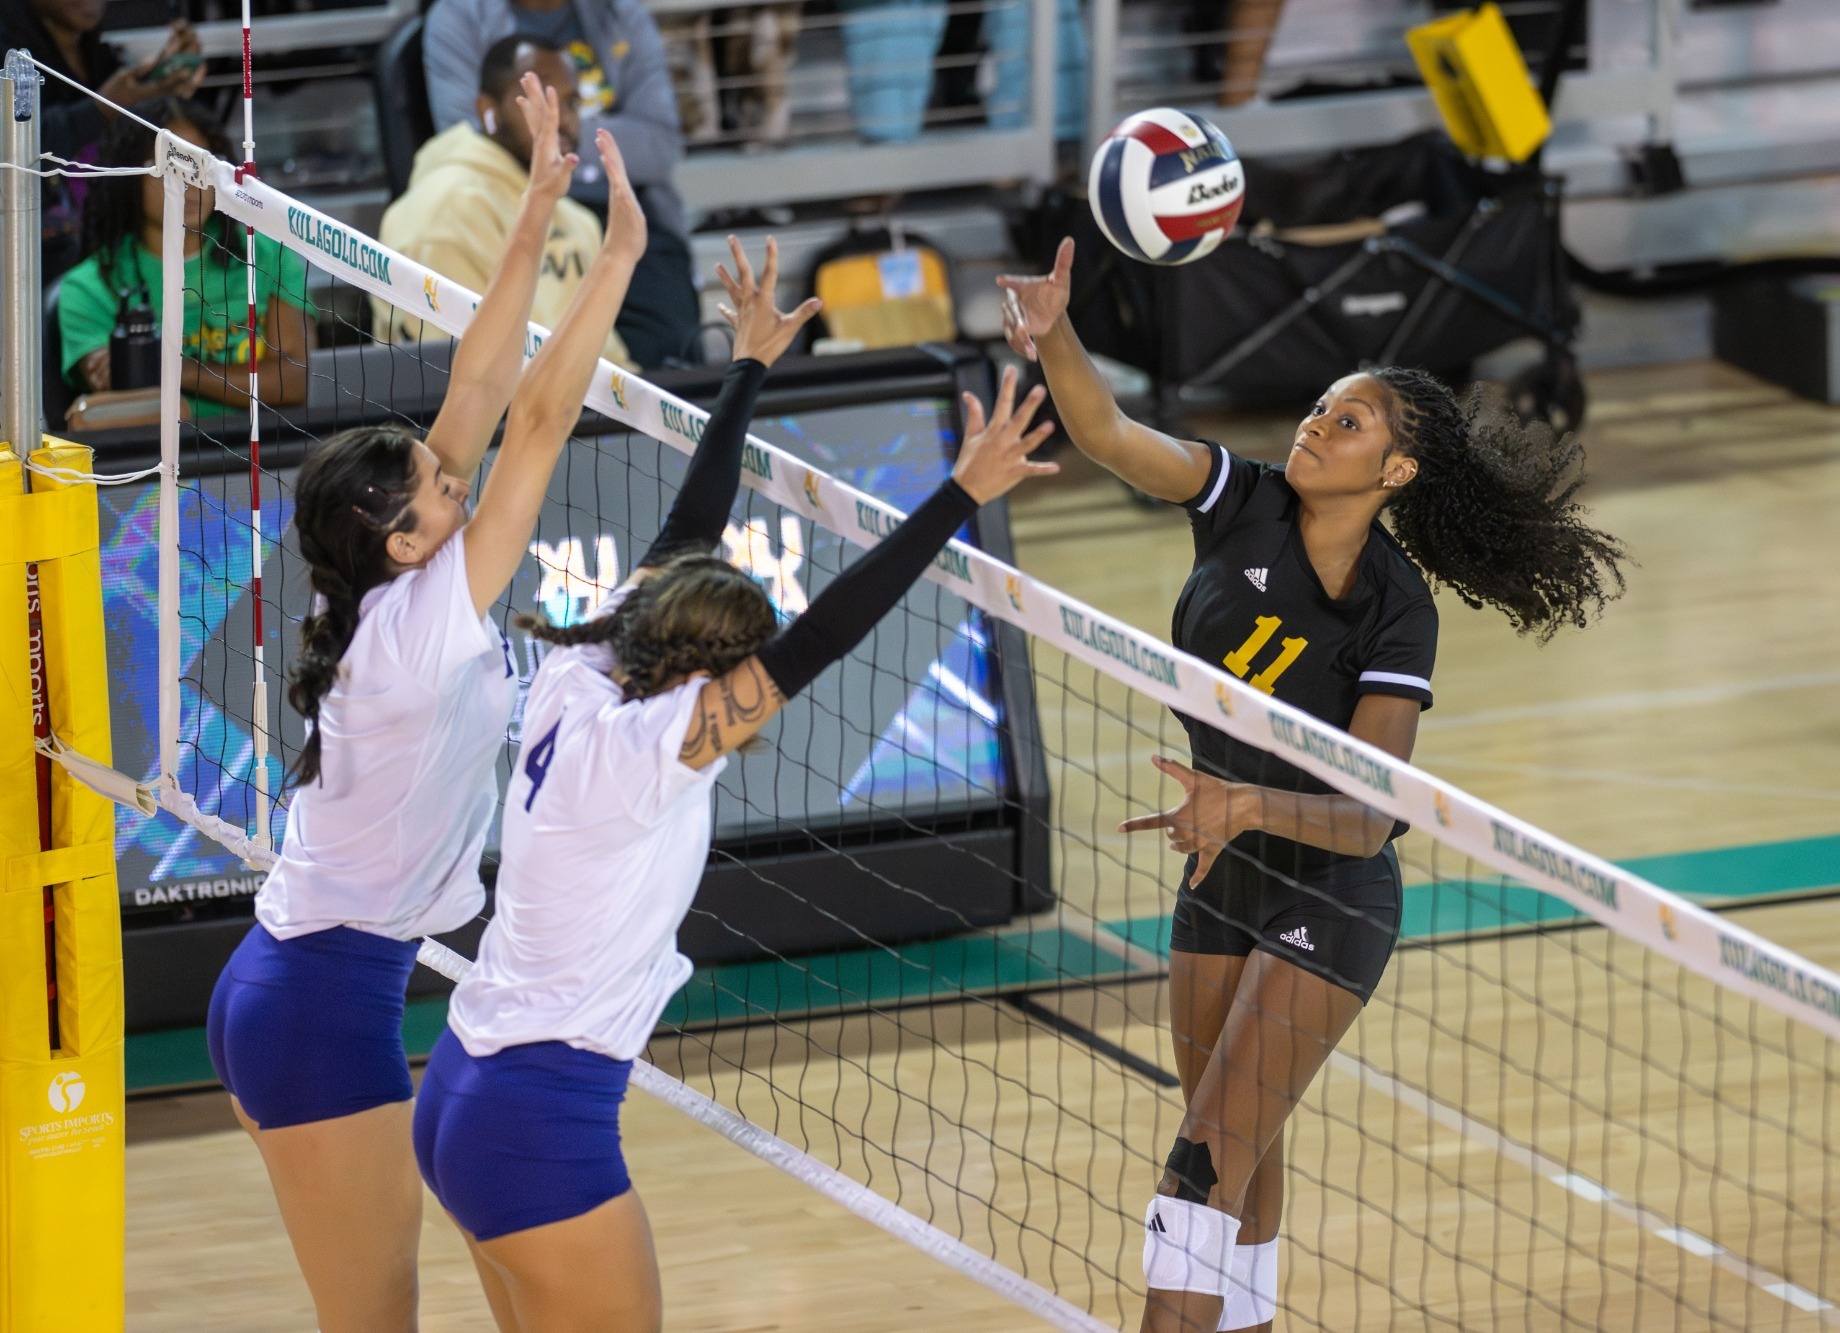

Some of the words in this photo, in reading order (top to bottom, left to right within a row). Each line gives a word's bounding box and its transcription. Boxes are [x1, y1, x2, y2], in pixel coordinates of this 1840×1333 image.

[1244, 568, 1268, 593] adidas
[1222, 615, 1309, 697] 11
[134, 874, 266, 907] DAKTRONIC
[1279, 932, 1315, 952] adidas
[20, 1121, 62, 1141] SPORTS
[65, 1112, 114, 1129] IMPORTS
